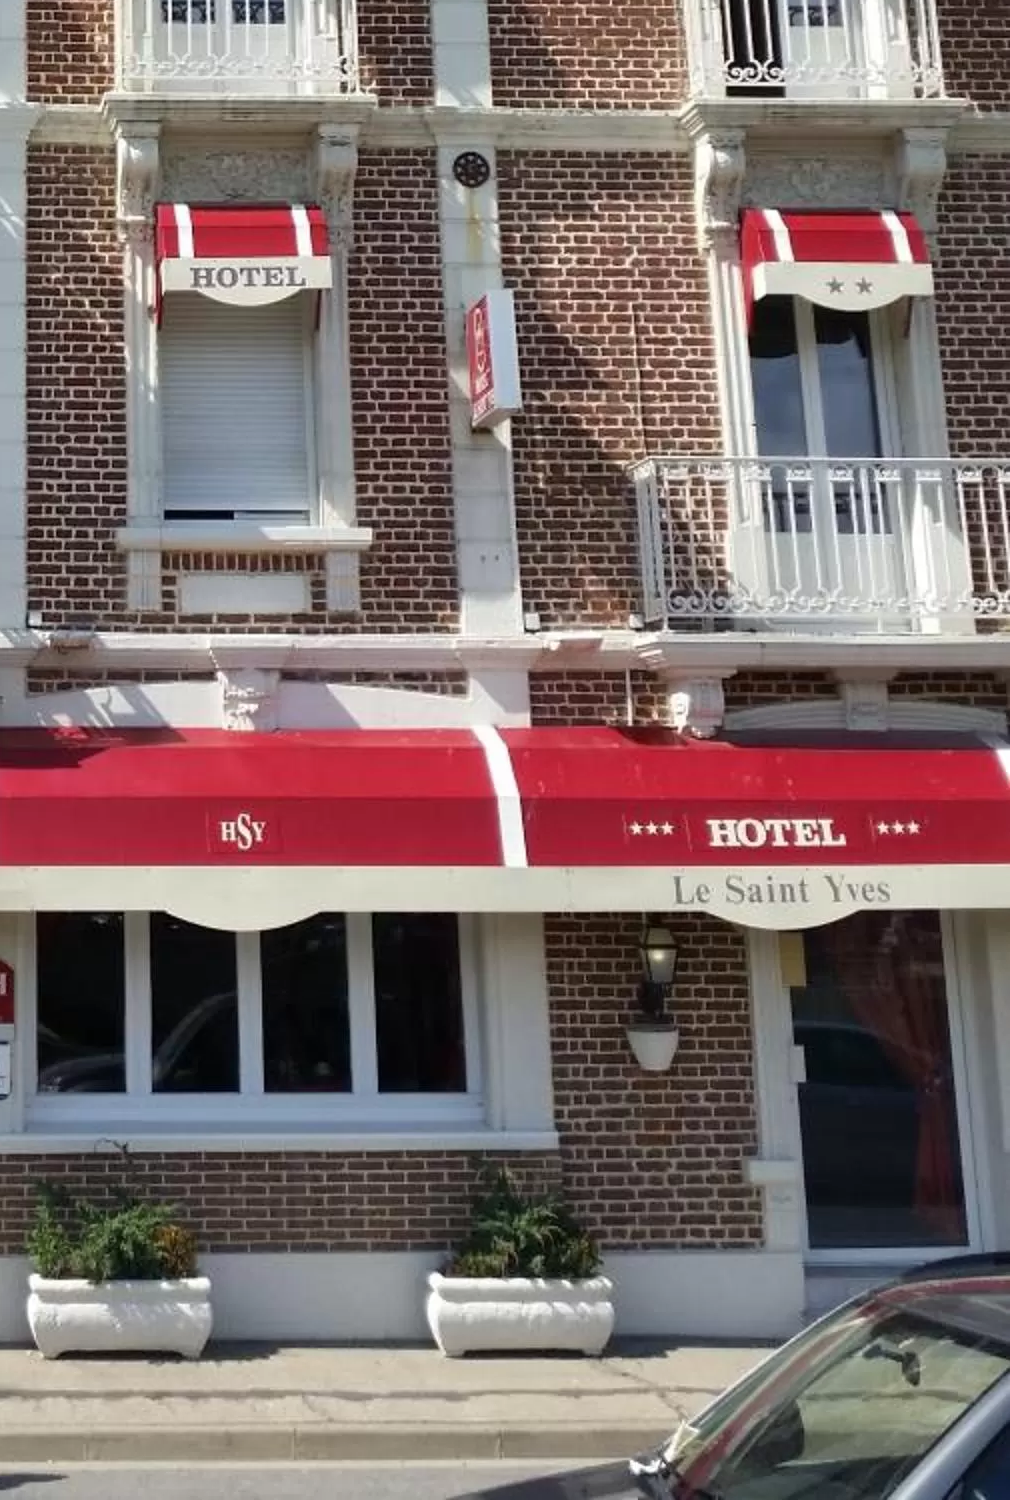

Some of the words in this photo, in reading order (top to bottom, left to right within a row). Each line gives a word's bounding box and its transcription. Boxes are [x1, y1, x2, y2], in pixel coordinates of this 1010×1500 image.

[190, 267, 306, 288] HOTEL
[219, 812, 266, 851] HSY
[706, 818, 847, 847] HOTEL
[673, 875, 711, 904] Le
[725, 875, 809, 904] Saint
[823, 874, 891, 903] Yves
